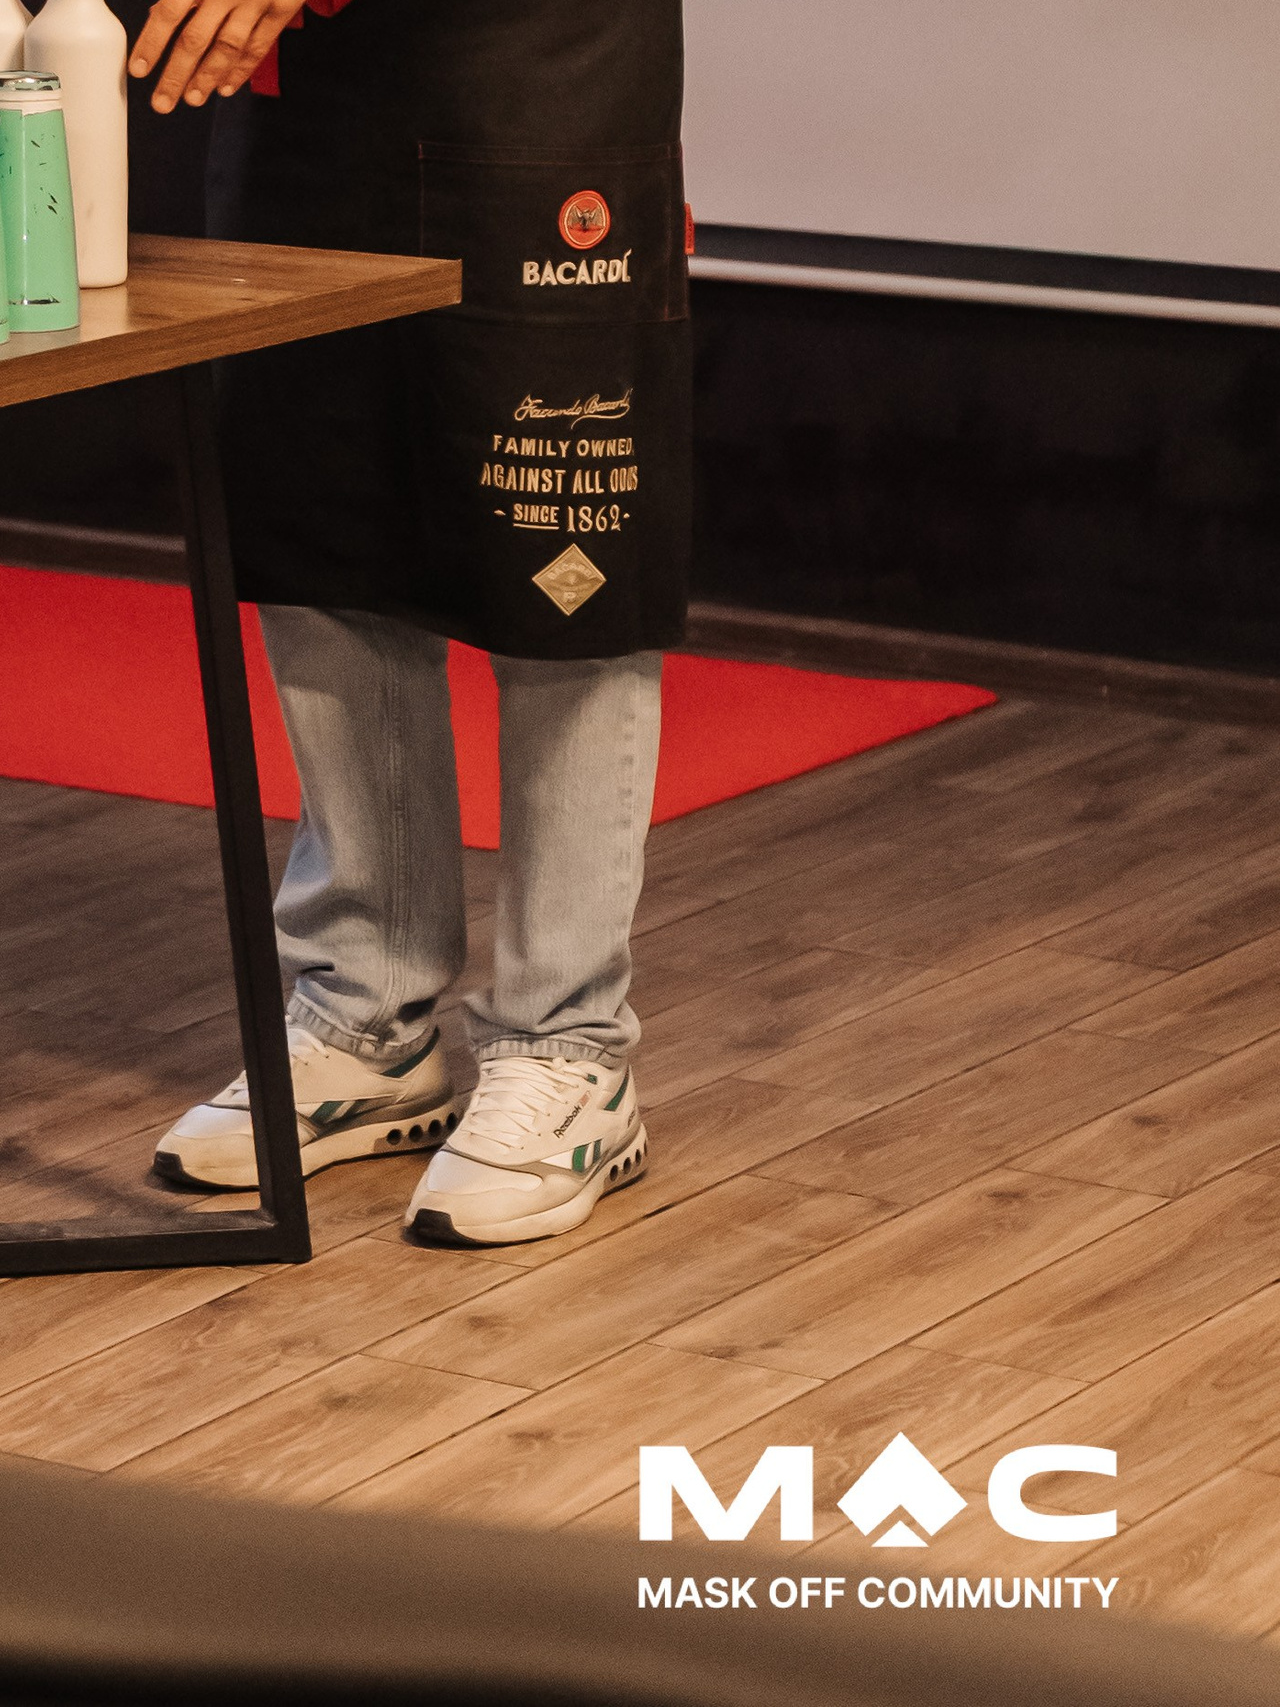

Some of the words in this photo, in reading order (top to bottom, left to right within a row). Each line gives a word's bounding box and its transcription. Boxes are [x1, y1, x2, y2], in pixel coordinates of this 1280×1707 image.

[493, 435, 570, 458] FAMILY
[576, 437, 634, 458] OWNED
[480, 462, 566, 494] AGAINST
[572, 470, 604, 494] ALL
[513, 503, 560, 524] SINCE
[567, 504, 621, 533] 1862
